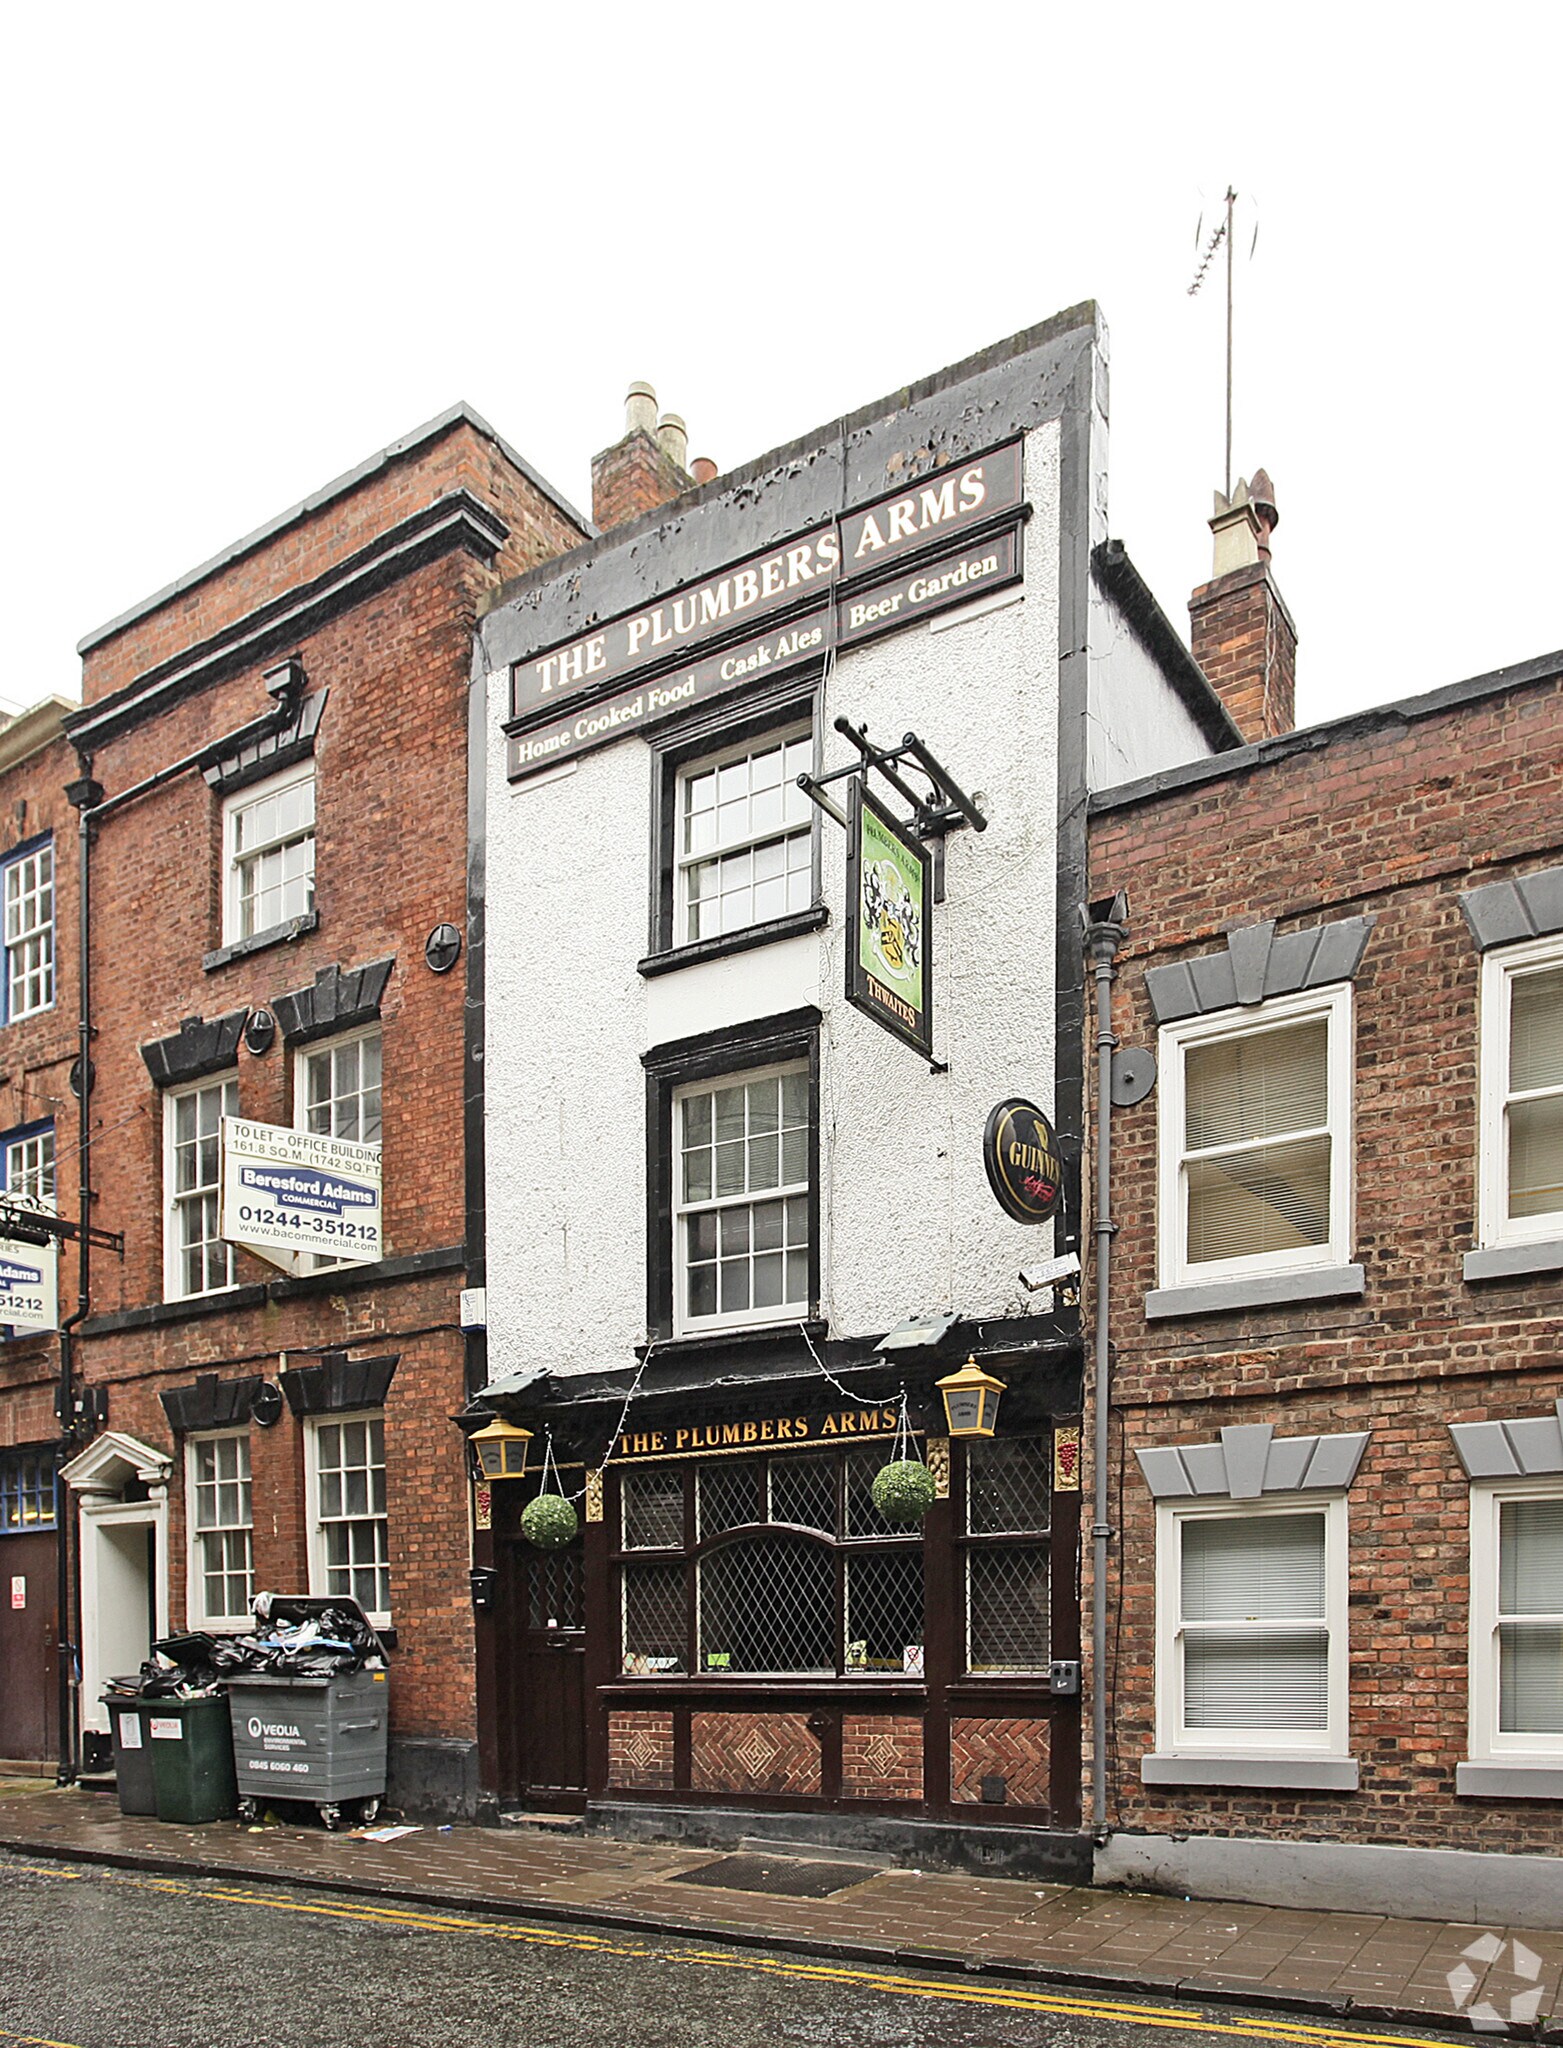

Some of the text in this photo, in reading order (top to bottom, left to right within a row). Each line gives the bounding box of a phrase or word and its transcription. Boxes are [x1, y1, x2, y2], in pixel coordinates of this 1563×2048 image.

[535, 466, 986, 694] THE PLUMBERS ARMS
[518, 555, 998, 764] Home Cooked Food Cask Ales Beer Garden
[866, 974, 916, 1028] THWAITES
[233, 1124, 250, 1137] TO
[253, 1128, 274, 1142] LET
[287, 1135, 328, 1153] OFFICE
[233, 1139, 266, 1154] 161.8
[269, 1146, 305, 1161] SQ.M.
[309, 1153, 341, 1168] (1742
[1009, 1141, 1060, 1185] GUINNES
[243, 1169, 373, 1204] Beresford Adams
[281, 1193, 337, 1210] COMMERCIAL
[239, 1205, 378, 1241] 01244-351212
[239, 1224, 378, 1252] www.bacommercial.com
[618, 1408, 898, 1454] THE PLUMBERS ARMS
[262, 1724, 301, 1737] VEOLIA
